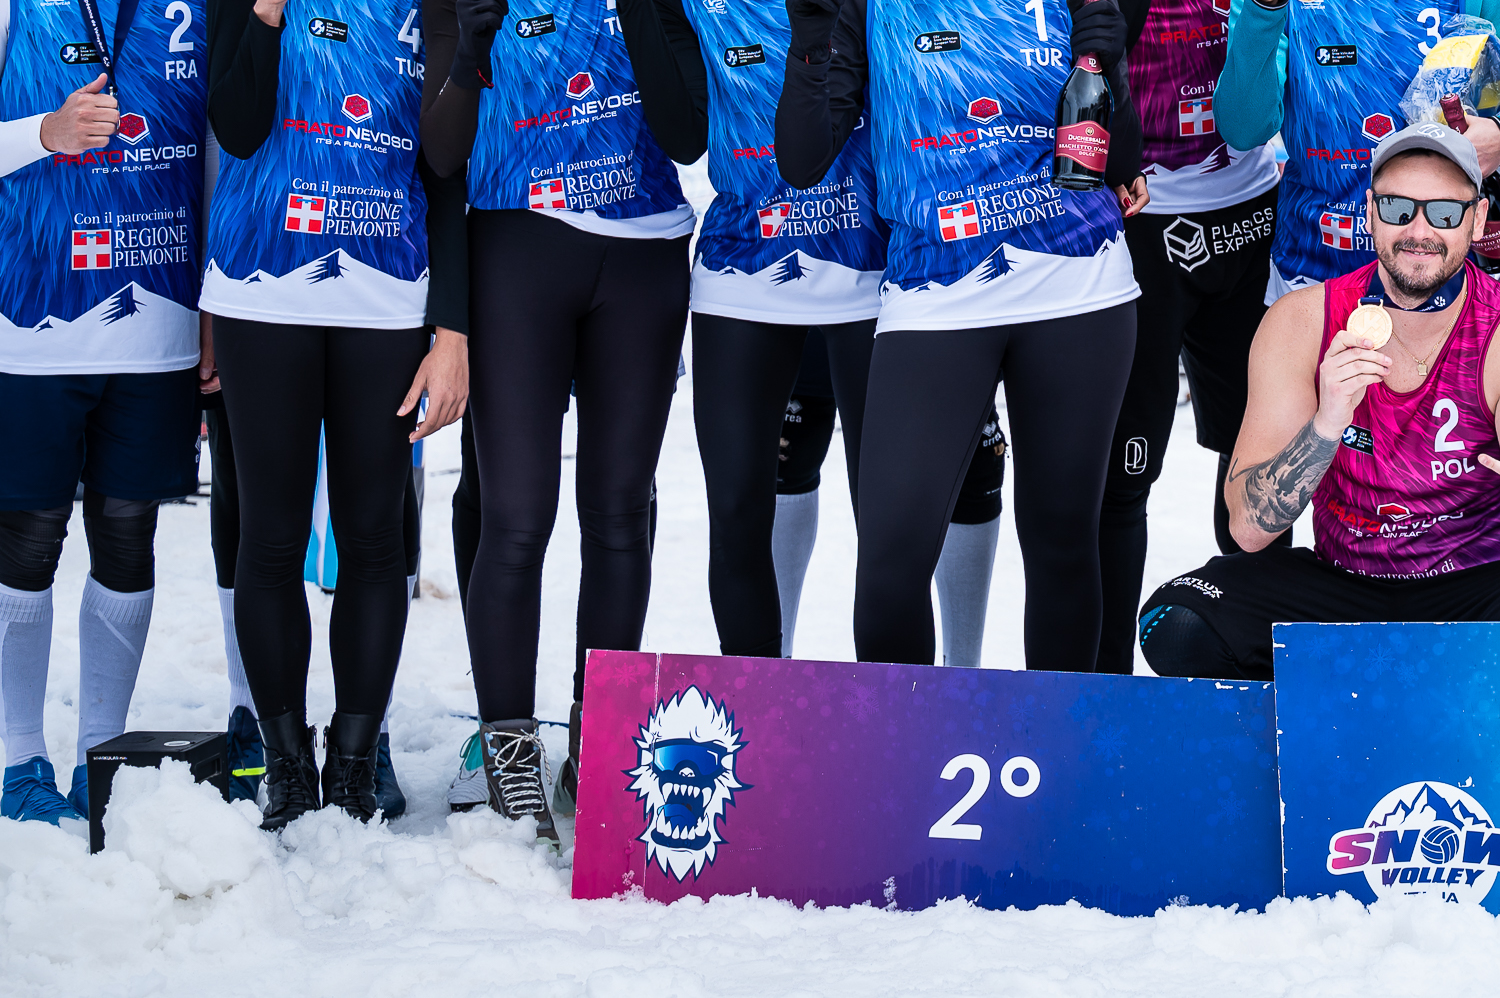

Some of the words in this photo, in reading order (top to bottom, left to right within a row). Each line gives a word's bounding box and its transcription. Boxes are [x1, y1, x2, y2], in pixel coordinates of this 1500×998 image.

[164, 0, 194, 53] 2
[398, 8, 423, 53] 4
[1417, 8, 1443, 55] 3
[395, 57, 425, 81] TUR
[1020, 48, 1063, 67] TUR
[164, 59, 198, 81] FRA
[1180, 84, 1204, 96] Con
[1206, 82, 1214, 94] il
[572, 115, 591, 127] FUN
[592, 110, 618, 122] PLACE
[284, 117, 413, 151] PRATONEVOSO
[315, 137, 332, 145] IT'S
[345, 140, 361, 149] FUN
[364, 143, 388, 154] PLACE
[53, 143, 197, 168] PRATONEVOSO
[949, 148, 966, 156] IT'S
[968, 146, 977, 154] A
[978, 141, 1000, 151] FUN
[91, 166, 110, 174] IT'S
[112, 166, 120, 174] A
[122, 165, 143, 173] FUN
[144, 162, 171, 171] PLACE
[530, 164, 553, 181] Con
[555, 162, 565, 175] il
[567, 153, 626, 175] patrocinio
[1341, 162, 1358, 170] IT'S
[292, 177, 317, 191] Con
[319, 179, 329, 193] il
[332, 182, 389, 200] patrocinio
[391, 187, 404, 199] di
[566, 164, 636, 194] REGIONE
[843, 175, 854, 189] di
[938, 188, 965, 202] Con
[966, 185, 976, 198] il
[977, 173, 1040, 197] patrocinio
[1040, 166, 1051, 181] di
[568, 184, 637, 210] PIEMONTE
[977, 183, 1062, 218] REGIONE
[74, 212, 101, 225] Con
[103, 211, 113, 224] il
[115, 208, 175, 225] patrocinio
[176, 206, 187, 219] di
[328, 199, 403, 220] REGIONE
[981, 199, 1066, 234] PIEMONTE
[114, 224, 189, 249] REGIONE
[324, 220, 401, 238] PIEMONTE
[779, 212, 862, 238] PIEMONTE
[114, 247, 189, 268] PIEMONTE
[1432, 399, 1465, 453] 2
[1431, 457, 1475, 481] POL
[1442, 559, 1456, 575] di
[1381, 865, 1485, 888] VOLLEY
